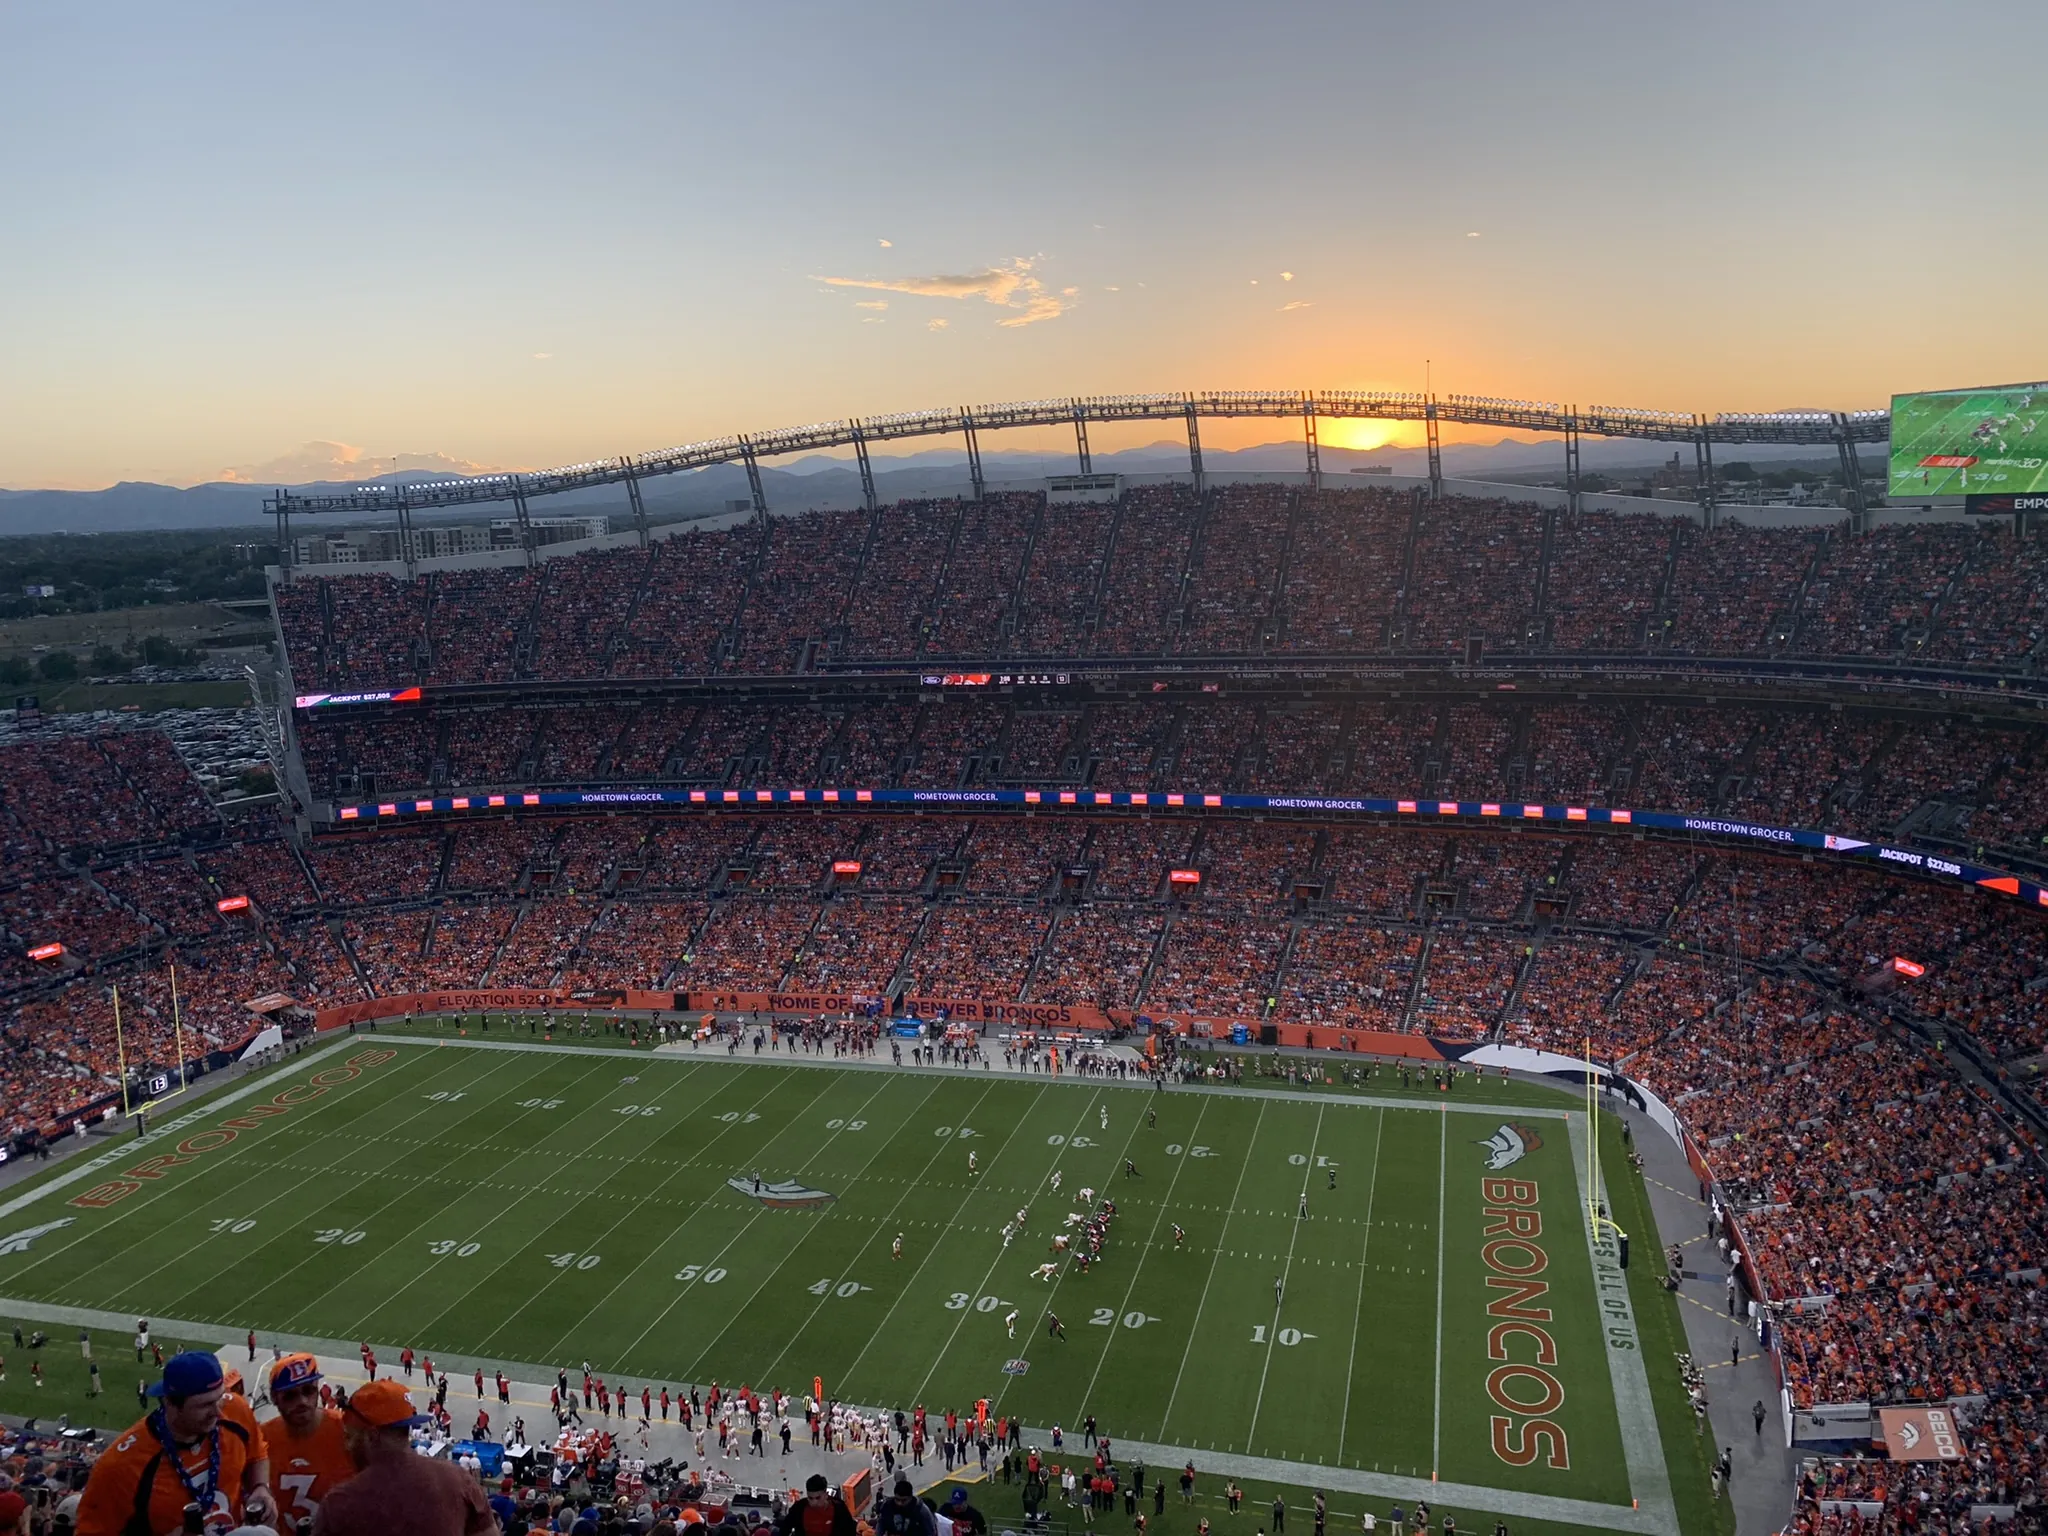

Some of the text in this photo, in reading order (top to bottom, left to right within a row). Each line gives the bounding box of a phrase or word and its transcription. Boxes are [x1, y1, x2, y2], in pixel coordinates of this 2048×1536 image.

[1702, 676, 1735, 684] ATWATER
[329, 694, 361, 703] JACKPOT
[581, 793, 664, 802] HOMETOWN GROCER.
[914, 792, 998, 801] HOMETOWN GROCER.
[1268, 798, 1365, 810] HOMETOWN GROCER.
[1685, 819, 1795, 842] HOMETOWN GROCER.
[1879, 848, 1961, 875] JACKPOT $27,505
[438, 994, 553, 1006] ELEVATION 5280
[771, 996, 820, 1009] HOME
[825, 997, 848, 1010] OF
[908, 1001, 1071, 1022] DENVER BRONCOS
[155, 1076, 165, 1090] 13
[66, 1048, 398, 1208] BRONCOS
[88, 1147, 133, 1167] END
[135, 1109, 211, 1144] RACISM
[209, 1218, 257, 1234] 10
[313, 1228, 367, 1245] 20
[430, 1239, 482, 1257] 30
[548, 1251, 602, 1270] 40
[674, 1265, 727, 1283] 50
[1597, 1262, 1622, 1291] ALL
[807, 1278, 860, 1297] 40
[944, 1292, 999, 1313] 30
[1603, 1299, 1630, 1321] OF
[1089, 1308, 1146, 1329] 20
[1481, 1177, 1570, 1470] BRONCOS
[1250, 1325, 1302, 1346] 10
[1608, 1326, 1635, 1351] US
[117, 1434, 137, 1452] 3
[1926, 1410, 1957, 1459] GEICO
[280, 1474, 320, 1530] 3
